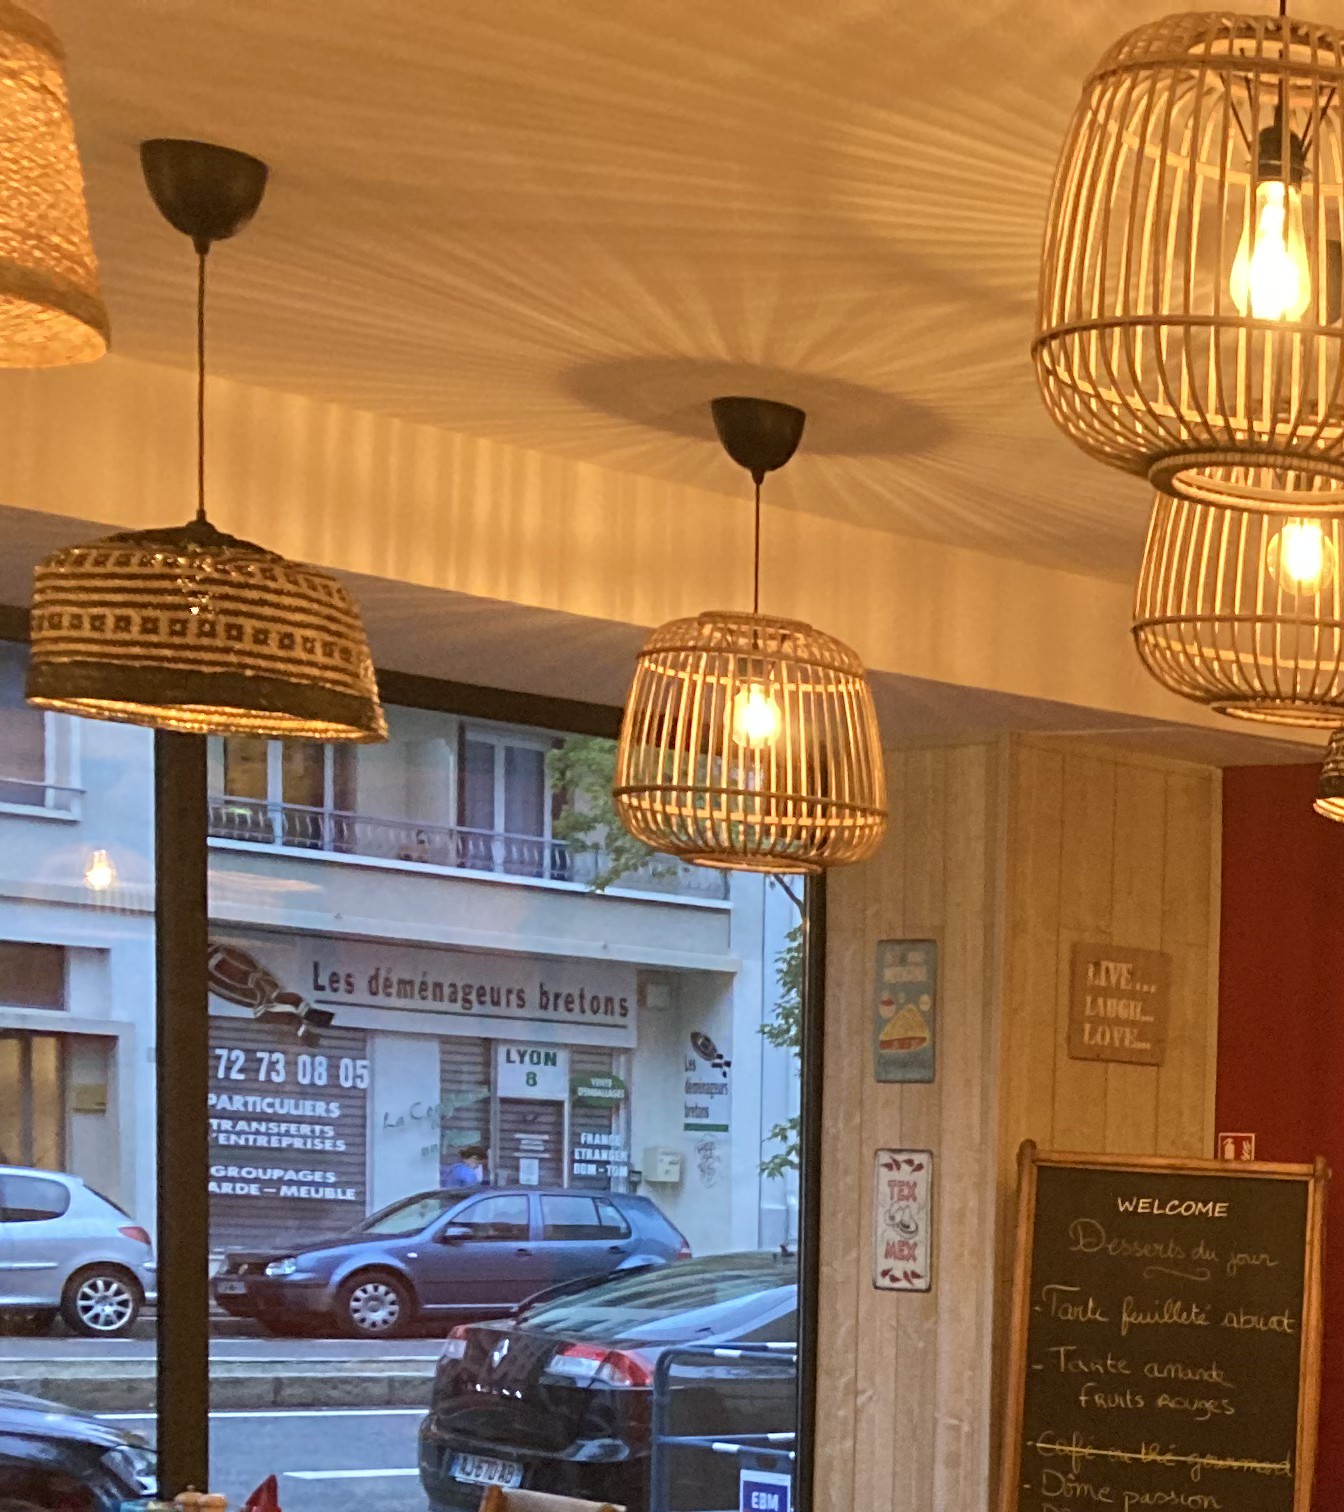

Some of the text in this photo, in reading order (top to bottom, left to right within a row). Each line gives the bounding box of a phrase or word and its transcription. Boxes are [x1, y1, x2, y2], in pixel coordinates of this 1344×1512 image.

[313, 961, 629, 1018] Les déménageurs bretons
[505, 1048, 558, 1067] LYON
[215, 1048, 370, 1089] 72 73 08 05
[526, 1071, 538, 1087] 8
[208, 1094, 342, 1118] PARTICULIERS
[208, 1118, 336, 1138] TRANSFERTS
[208, 1133, 347, 1151] 'ENTREPRISES
[210, 1165, 337, 1183] GROUPAGES
[208, 1181, 262, 1196] ARDE
[279, 1185, 357, 1200] MEUBLE
[887, 1179, 918, 1202] TEX
[1117, 1196, 1230, 1217] WELCOME
[884, 1240, 918, 1262] MEX
[1068, 1218, 1279, 1276] Desserts du jour
[1049, 1346, 1131, 1374] Tarte
[751, 1491, 779, 1512] EBM
